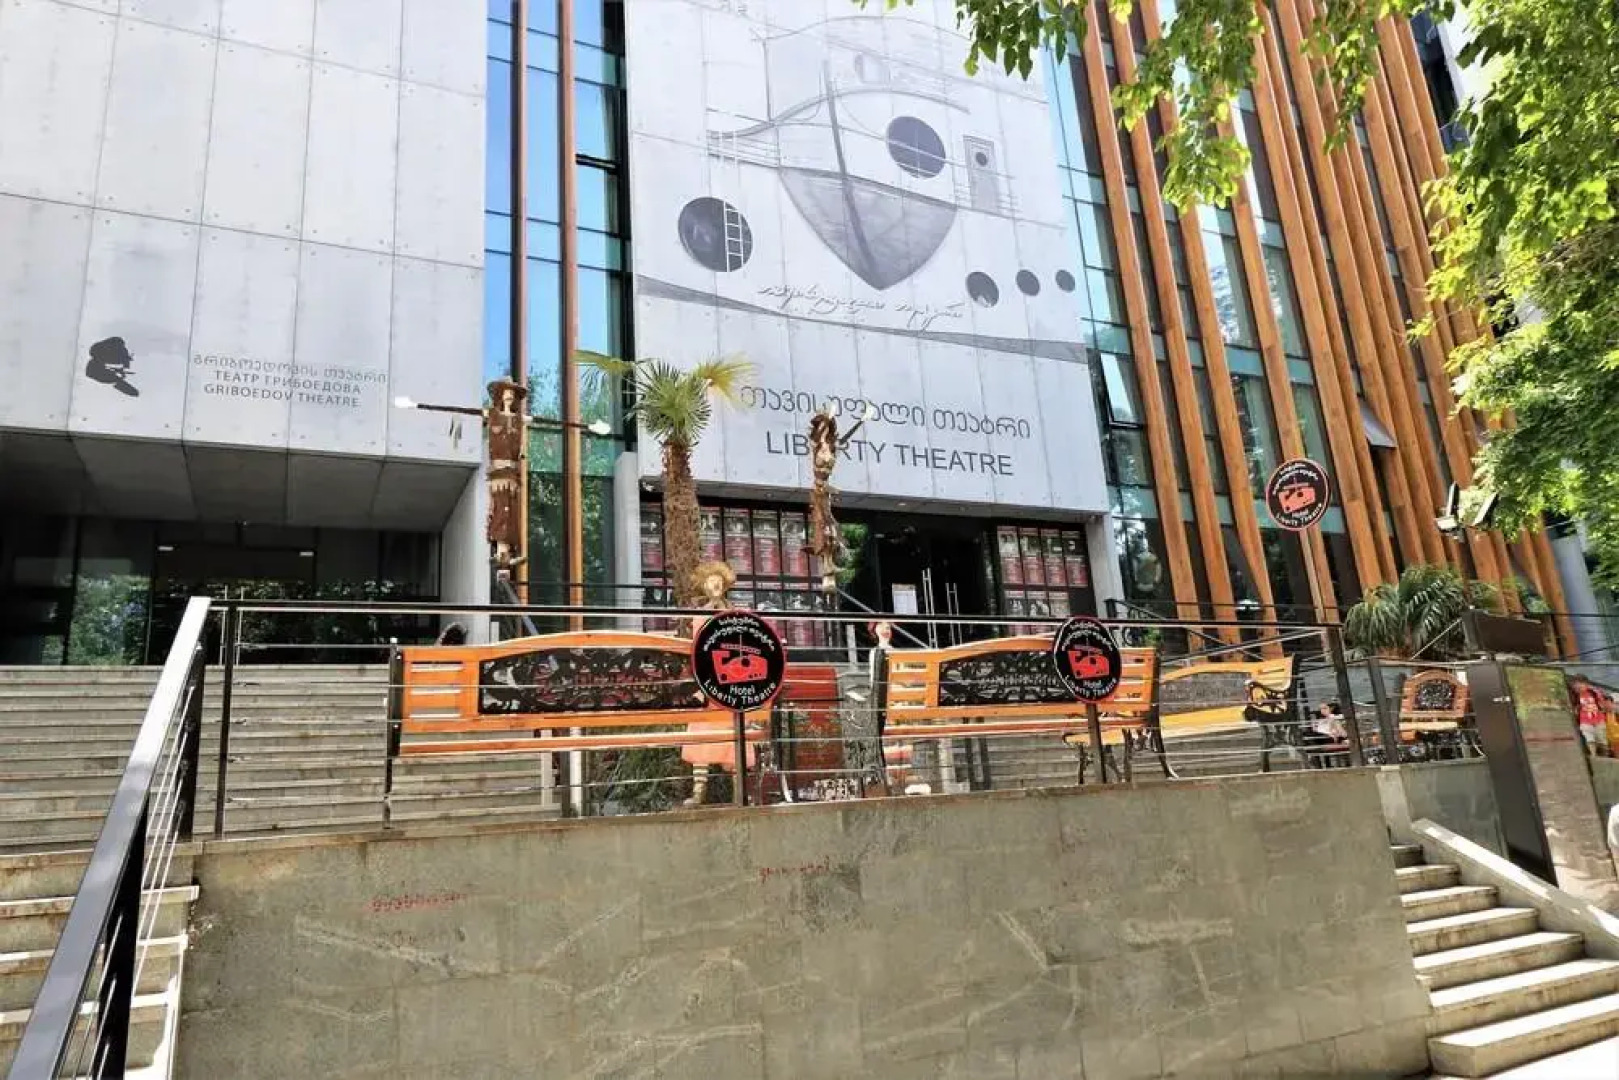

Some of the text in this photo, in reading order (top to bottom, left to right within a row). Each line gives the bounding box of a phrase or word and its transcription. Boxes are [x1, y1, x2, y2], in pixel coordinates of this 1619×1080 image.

[215, 370, 362, 394] ТЕАТР ГРИБОЕДОВА
[204, 383, 361, 408] GRIBOEDOV THEATRE
[933, 408, 1031, 439] თეატრი
[767, 431, 1014, 476] LIBRTY THEATRE
[704, 679, 776, 706] Liberty Theatre
[729, 684, 756, 695] Hotel
